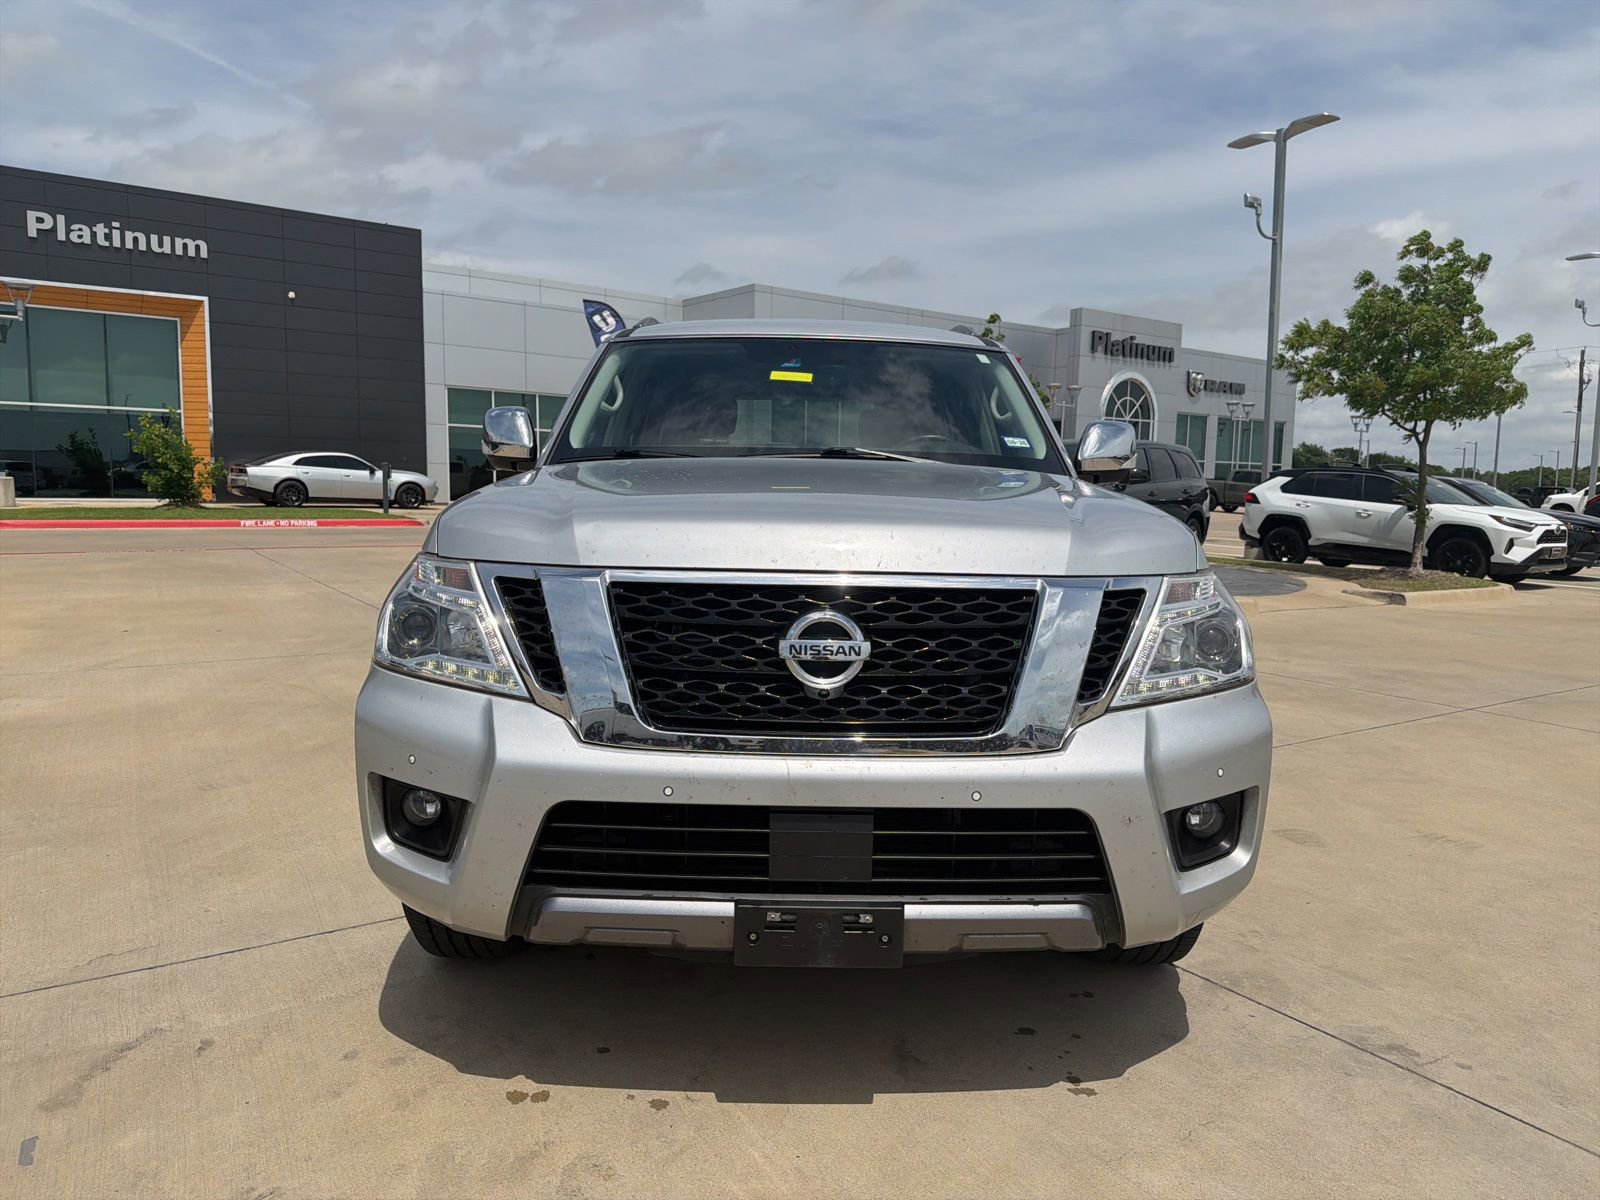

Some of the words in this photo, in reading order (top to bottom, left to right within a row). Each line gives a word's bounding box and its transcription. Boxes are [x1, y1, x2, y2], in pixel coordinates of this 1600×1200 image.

[26, 209, 208, 259] Platinum
[1091, 330, 1175, 363] Platinum
[1204, 379, 1246, 395] RAM
[240, 519, 257, 528] FIRE
[290, 519, 318, 528] PARKING
[789, 643, 862, 657] NISSAN
